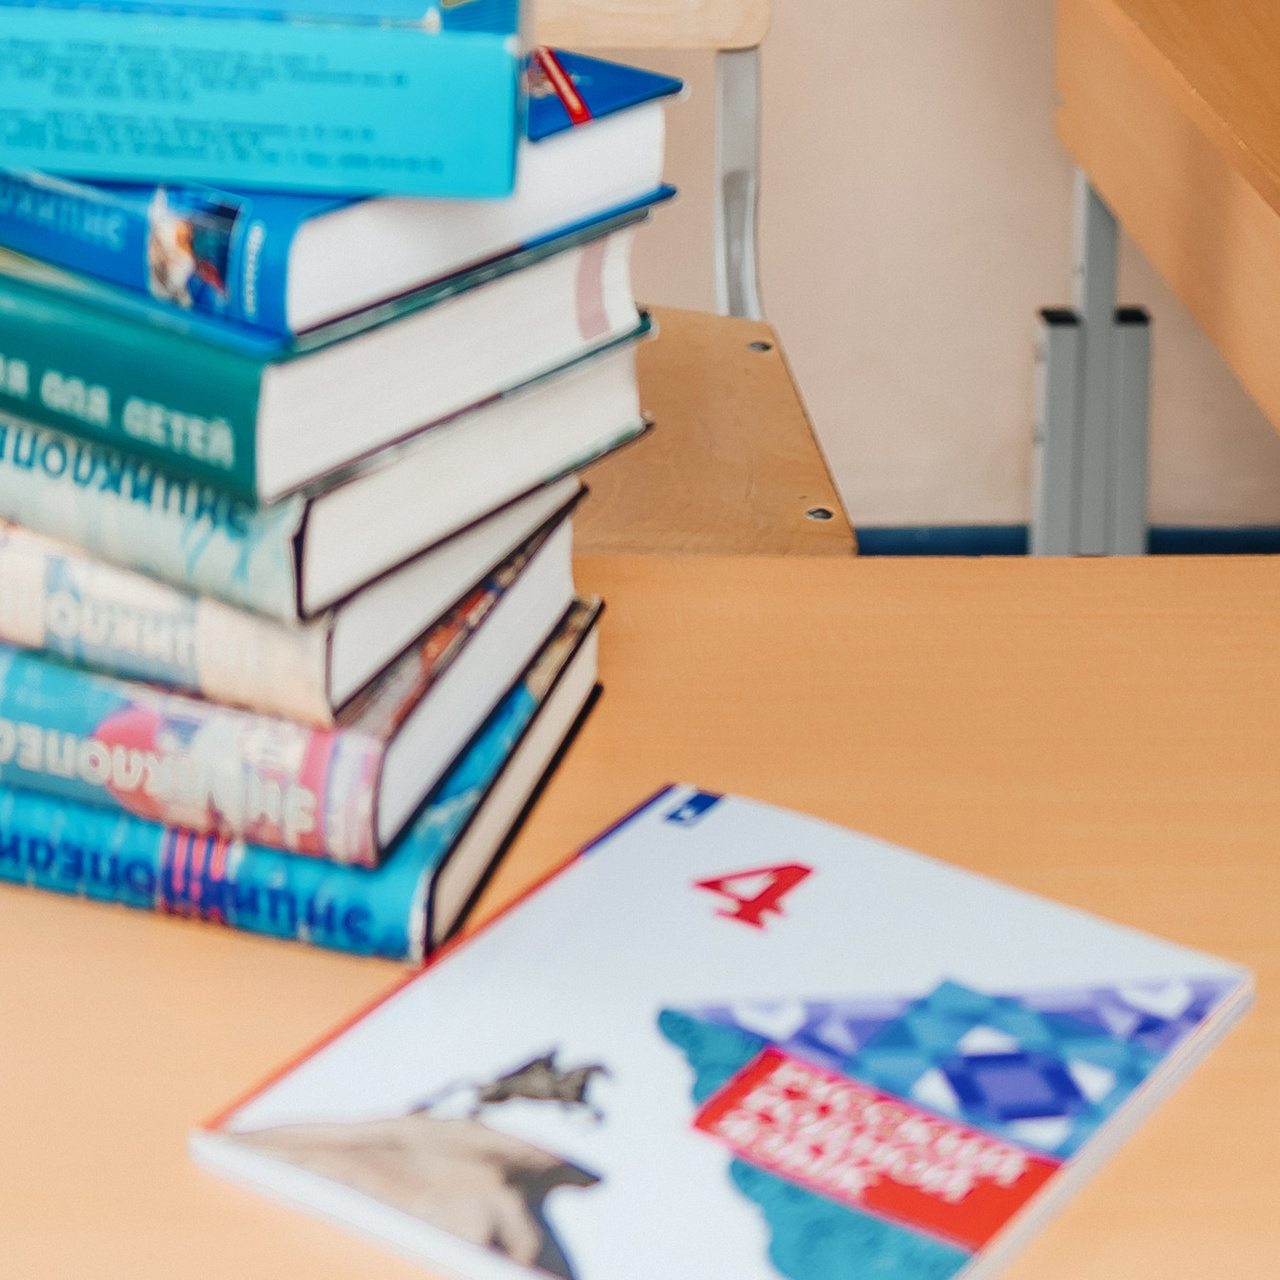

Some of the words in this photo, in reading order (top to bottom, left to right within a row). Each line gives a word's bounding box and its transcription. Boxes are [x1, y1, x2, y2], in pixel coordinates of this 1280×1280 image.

[39, 368, 112, 429] ДЛЯ
[122, 393, 236, 471] ДЕТЕЙ
[692, 861, 816, 931] 4
